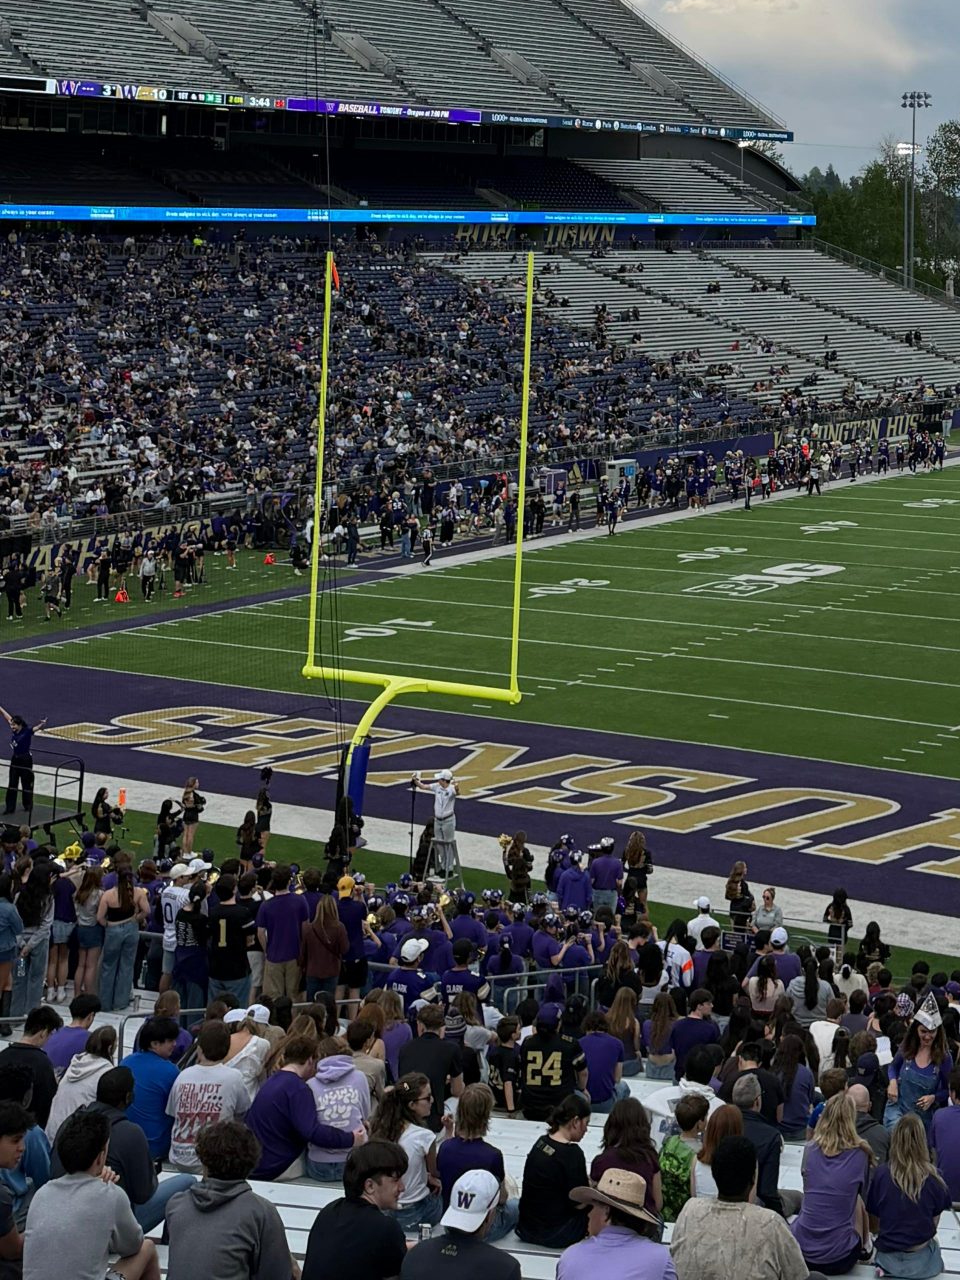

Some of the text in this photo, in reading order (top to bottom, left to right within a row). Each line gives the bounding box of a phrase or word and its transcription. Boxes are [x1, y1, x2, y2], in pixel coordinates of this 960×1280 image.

[338, 103, 377, 114] BASEBALL
[528, 577, 611, 596] 20
[343, 617, 438, 638] 10
[218, 918, 227, 947] 1
[392, 982, 408, 993] CLARK
[446, 984, 463, 994] CLARK
[526, 1050, 562, 1086] 24
[179, 1083, 222, 1094] RED HOT
[178, 1101, 223, 1112] PEPPERS
[457, 1190, 476, 1210] W
